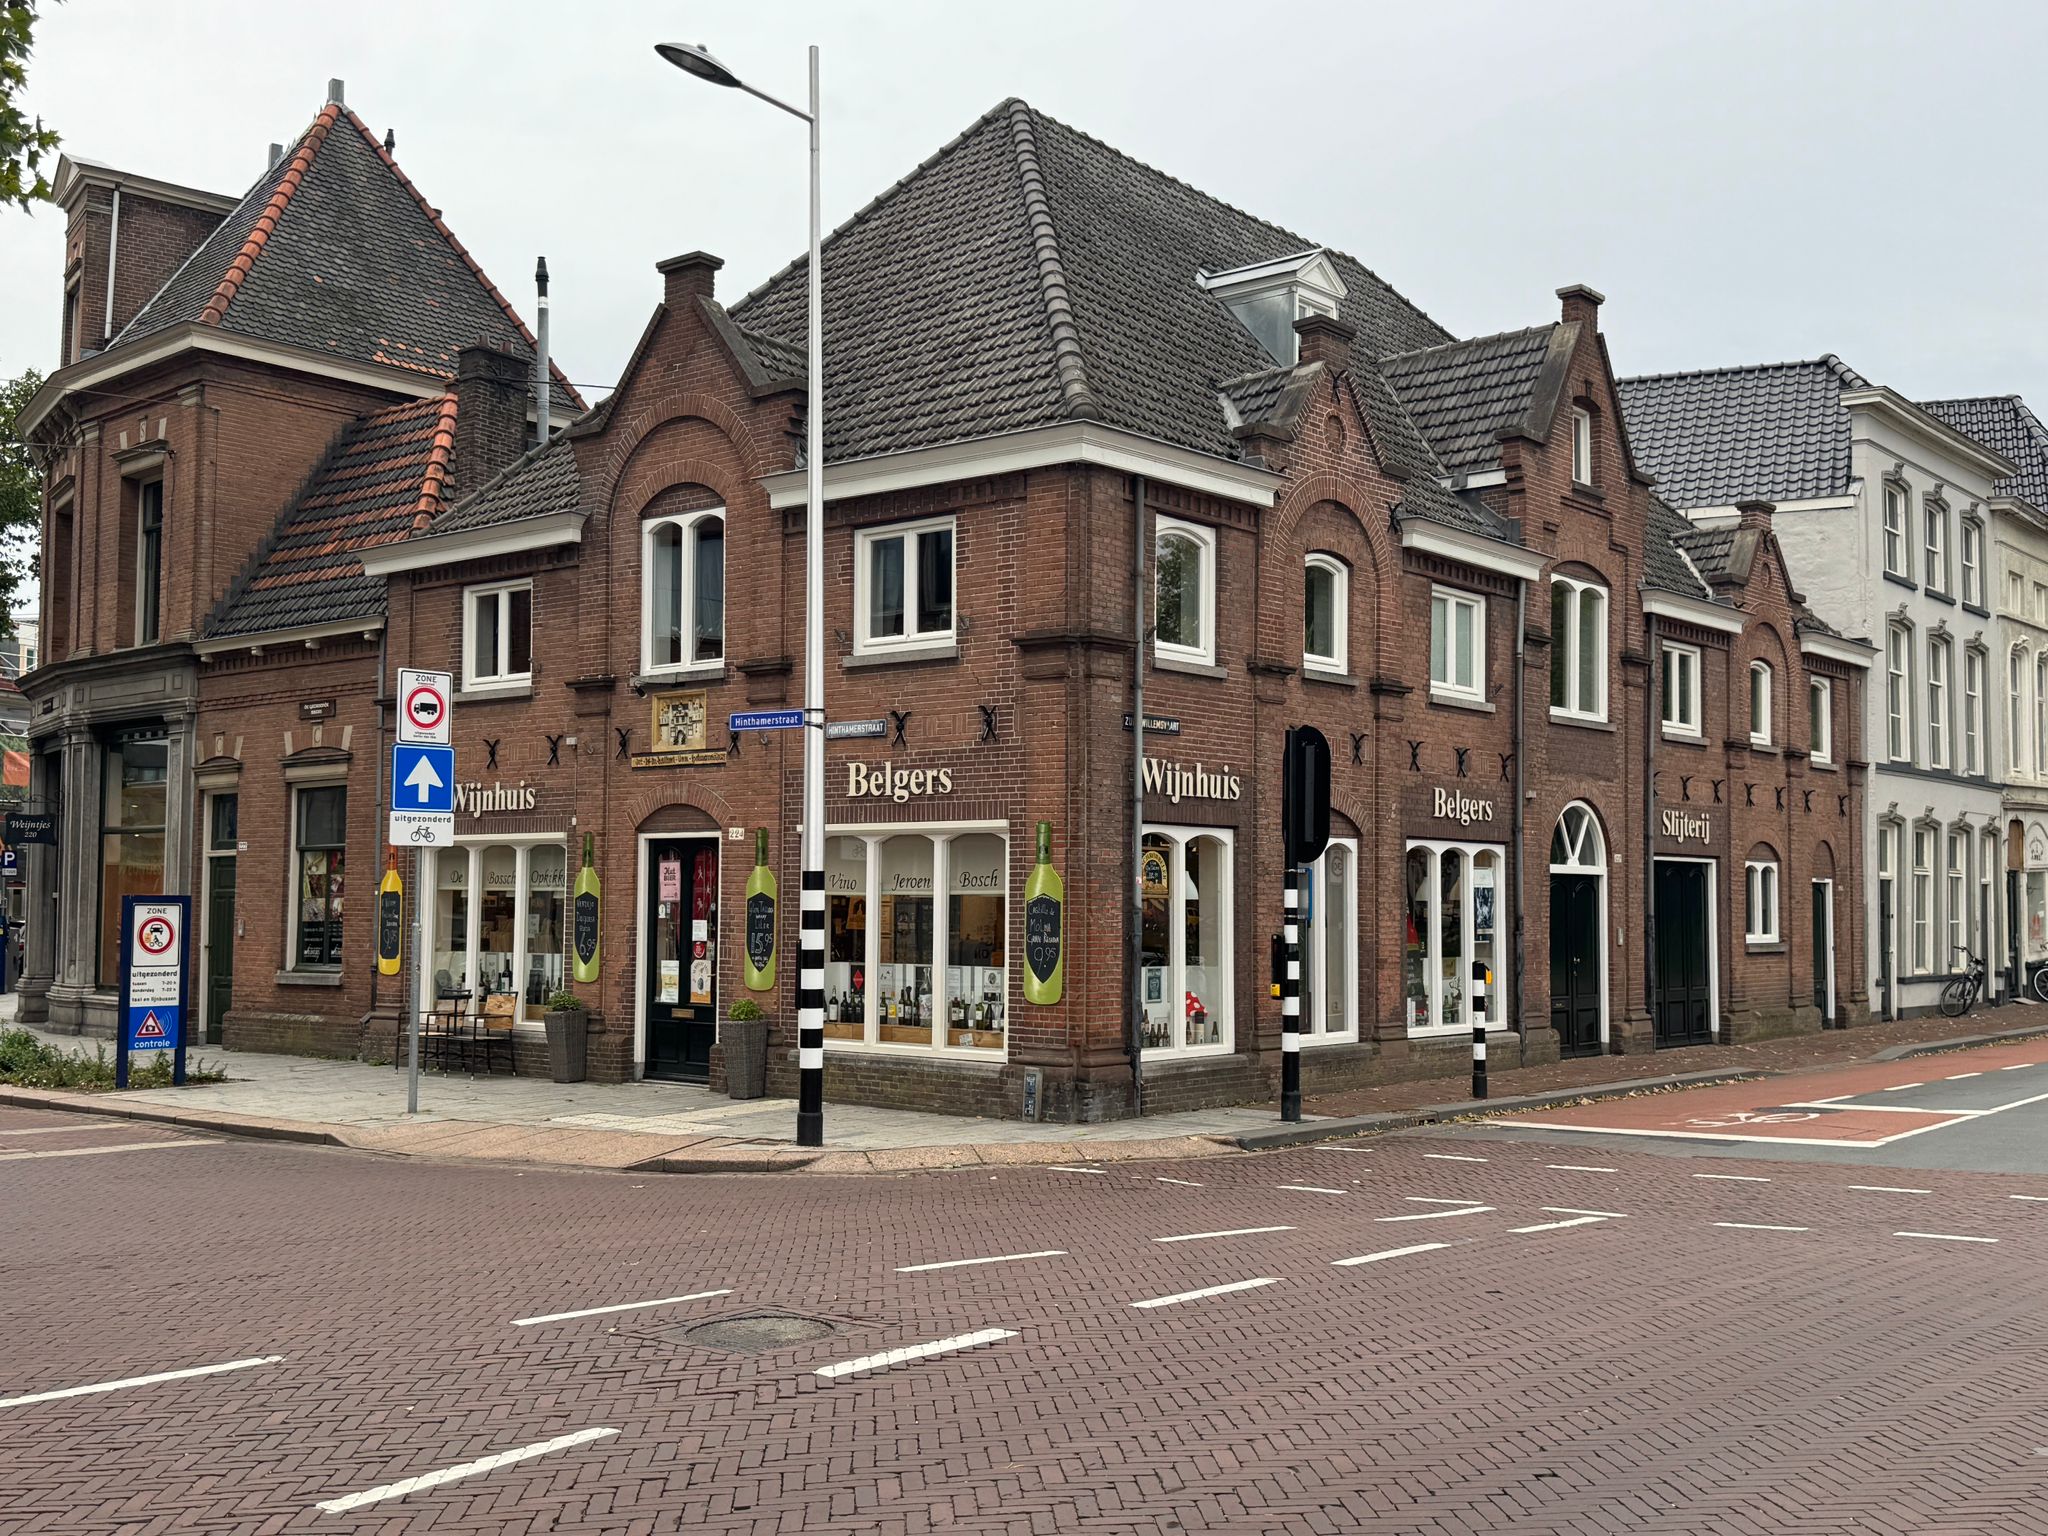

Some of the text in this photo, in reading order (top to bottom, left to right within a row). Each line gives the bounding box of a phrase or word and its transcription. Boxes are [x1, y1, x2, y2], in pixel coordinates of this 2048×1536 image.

[415, 674, 438, 683] ZONE
[735, 716, 799, 727] Hinthamerstraat
[828, 722, 884, 735] HINTHAMERSTRAAT
[846, 761, 953, 803] Belgers
[1141, 757, 1240, 804] Wijnhuis
[453, 780, 536, 818] Wijnhuis
[1433, 787, 1493, 826] Belgers
[9, 820, 51, 831] Weijntjes
[394, 815, 452, 824] uitgezonderd
[1662, 810, 1710, 844] Slijterij
[450, 870, 463, 883] De
[829, 868, 998, 892] Vino Jeroen Bosch
[132, 970, 178, 979] uitgezonderd
[134, 1040, 171, 1049] controle
